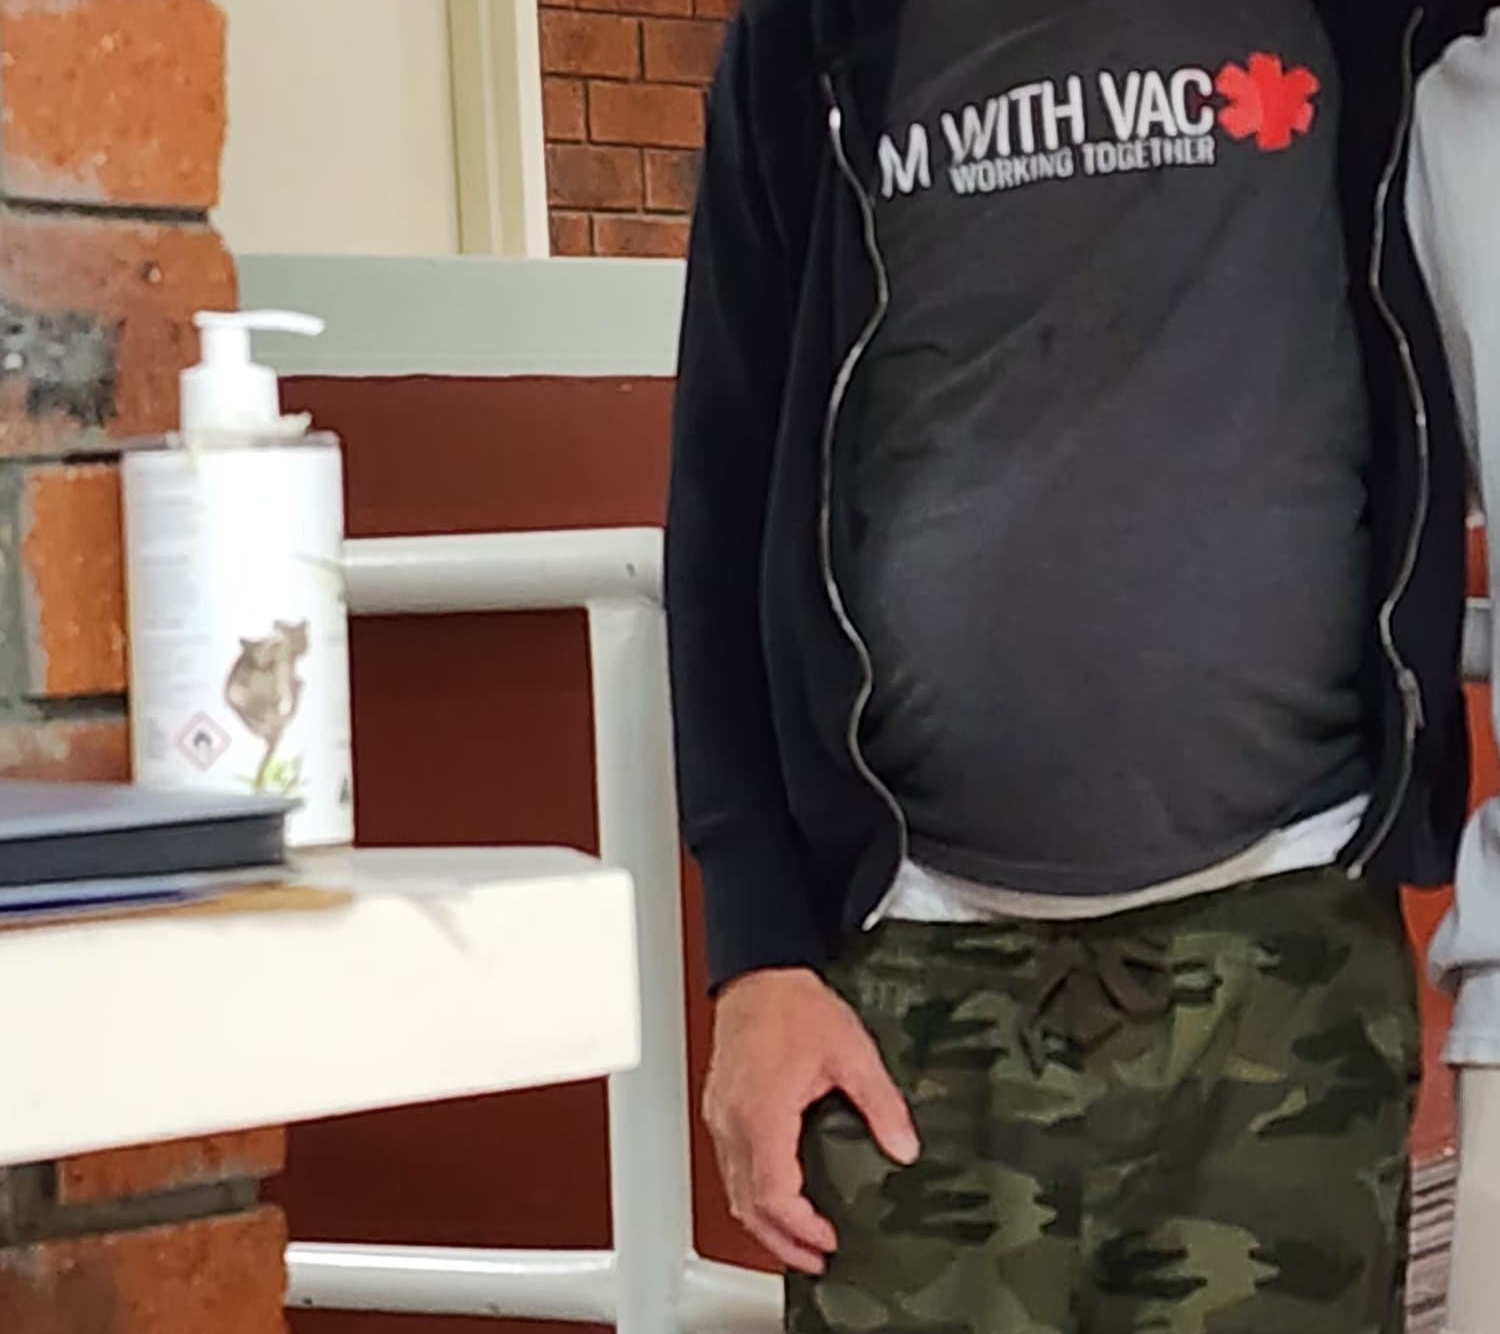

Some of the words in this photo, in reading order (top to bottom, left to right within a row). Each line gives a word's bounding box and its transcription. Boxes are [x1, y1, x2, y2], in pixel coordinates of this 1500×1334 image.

[941, 75, 1085, 161] WITH
[1098, 69, 1214, 140] VAC
[949, 151, 1073, 193] WORKING
[1083, 138, 1215, 174] TOGETHER
